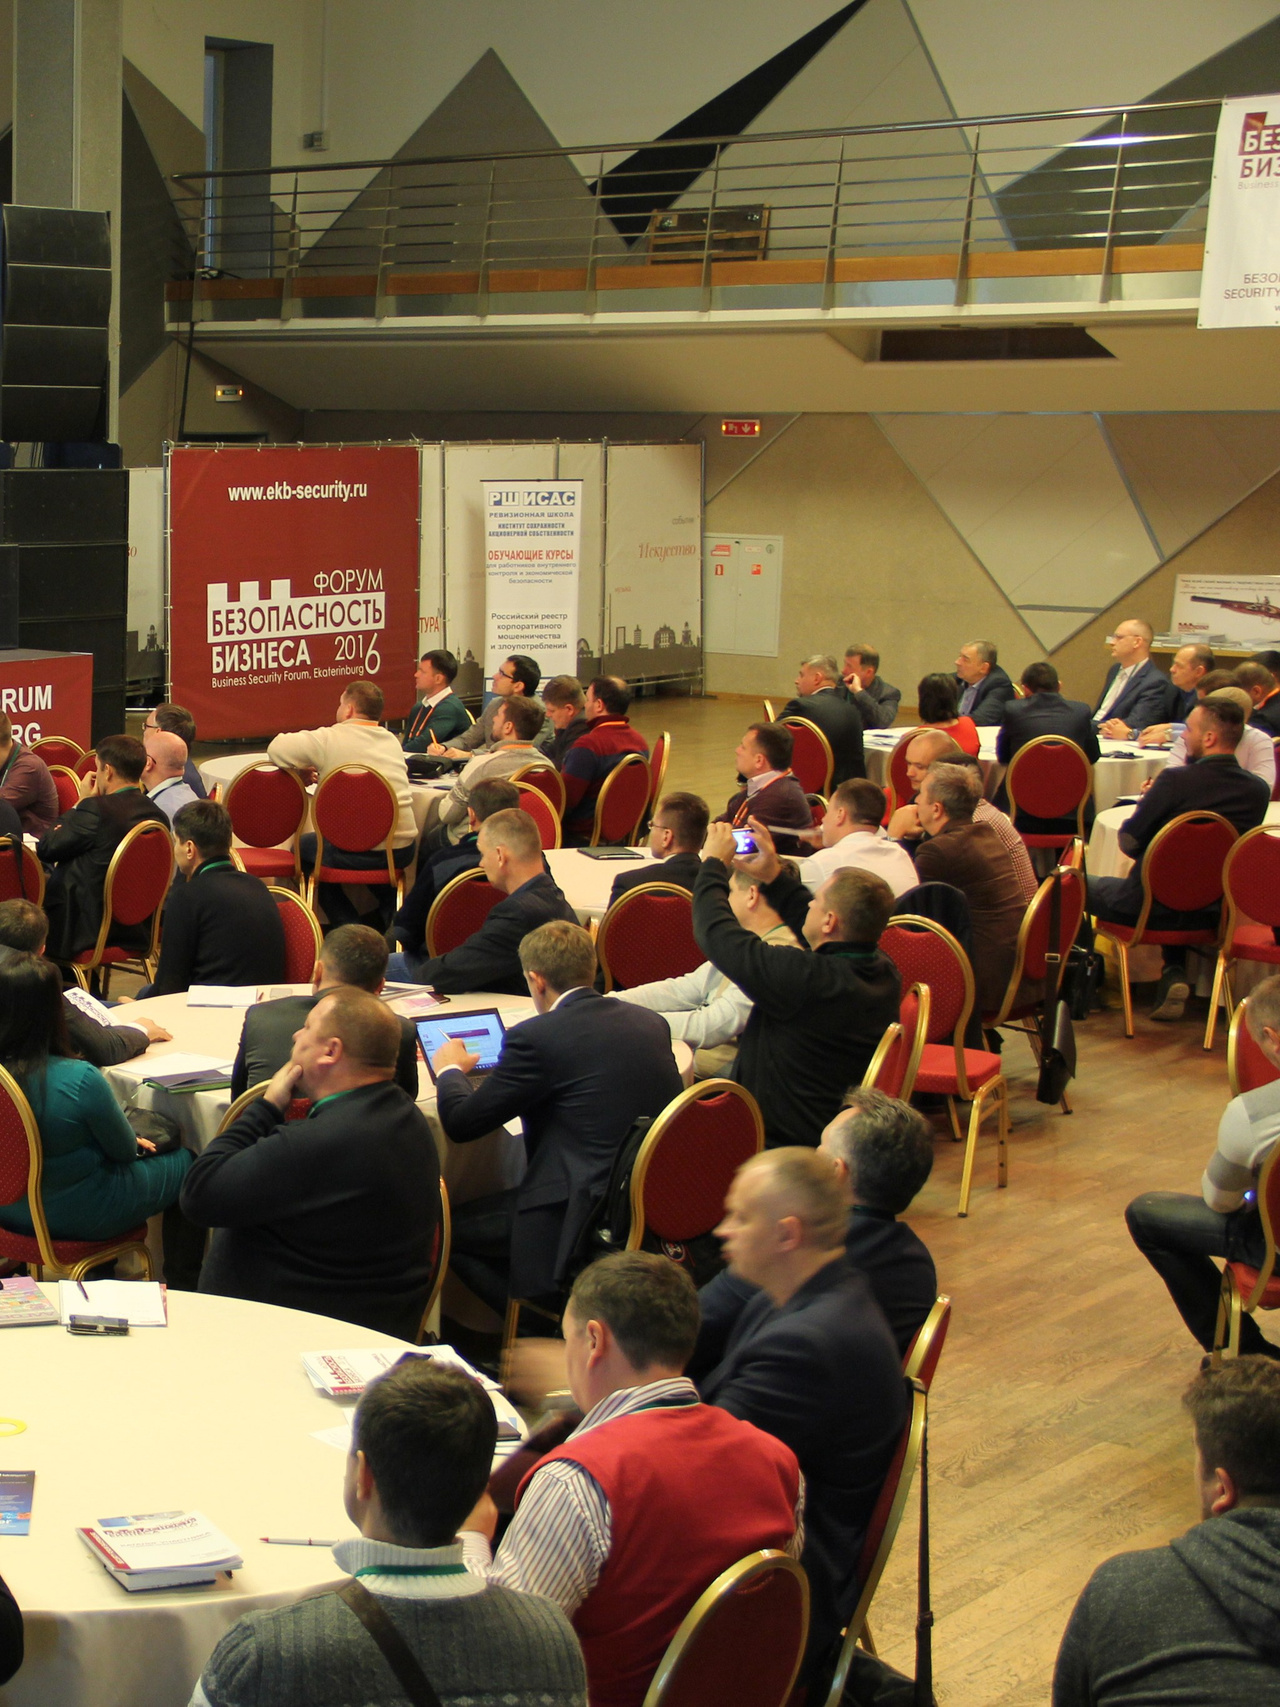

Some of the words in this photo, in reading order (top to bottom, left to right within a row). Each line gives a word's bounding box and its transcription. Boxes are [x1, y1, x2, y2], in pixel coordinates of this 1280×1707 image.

[1243, 272, 1280, 284] БЕЗО
[1223, 287, 1280, 299] SECURITY
[227, 480, 368, 502] www.ekb-security.ru
[489, 491, 519, 506] РШ
[523, 491, 575, 506] ИСАС
[488, 550, 543, 561] ОБУЧАЮЩИЕ
[545, 549, 574, 560] КУРСЫ
[638, 542, 696, 562] Искусство
[313, 568, 383, 594] ФОРУМ
[212, 599, 383, 637] БЕЗОПАСНОСТЬ
[497, 623, 562, 631] корпоративного
[212, 639, 312, 674] БИЗНЕСА
[334, 632, 381, 675] 2016
[498, 642, 567, 651] злоупотреблений
[212, 676, 247, 688] Business
[248, 671, 282, 684] Security
[284, 669, 312, 681] Forum,
[313, 665, 364, 678] Ekaterinburg
